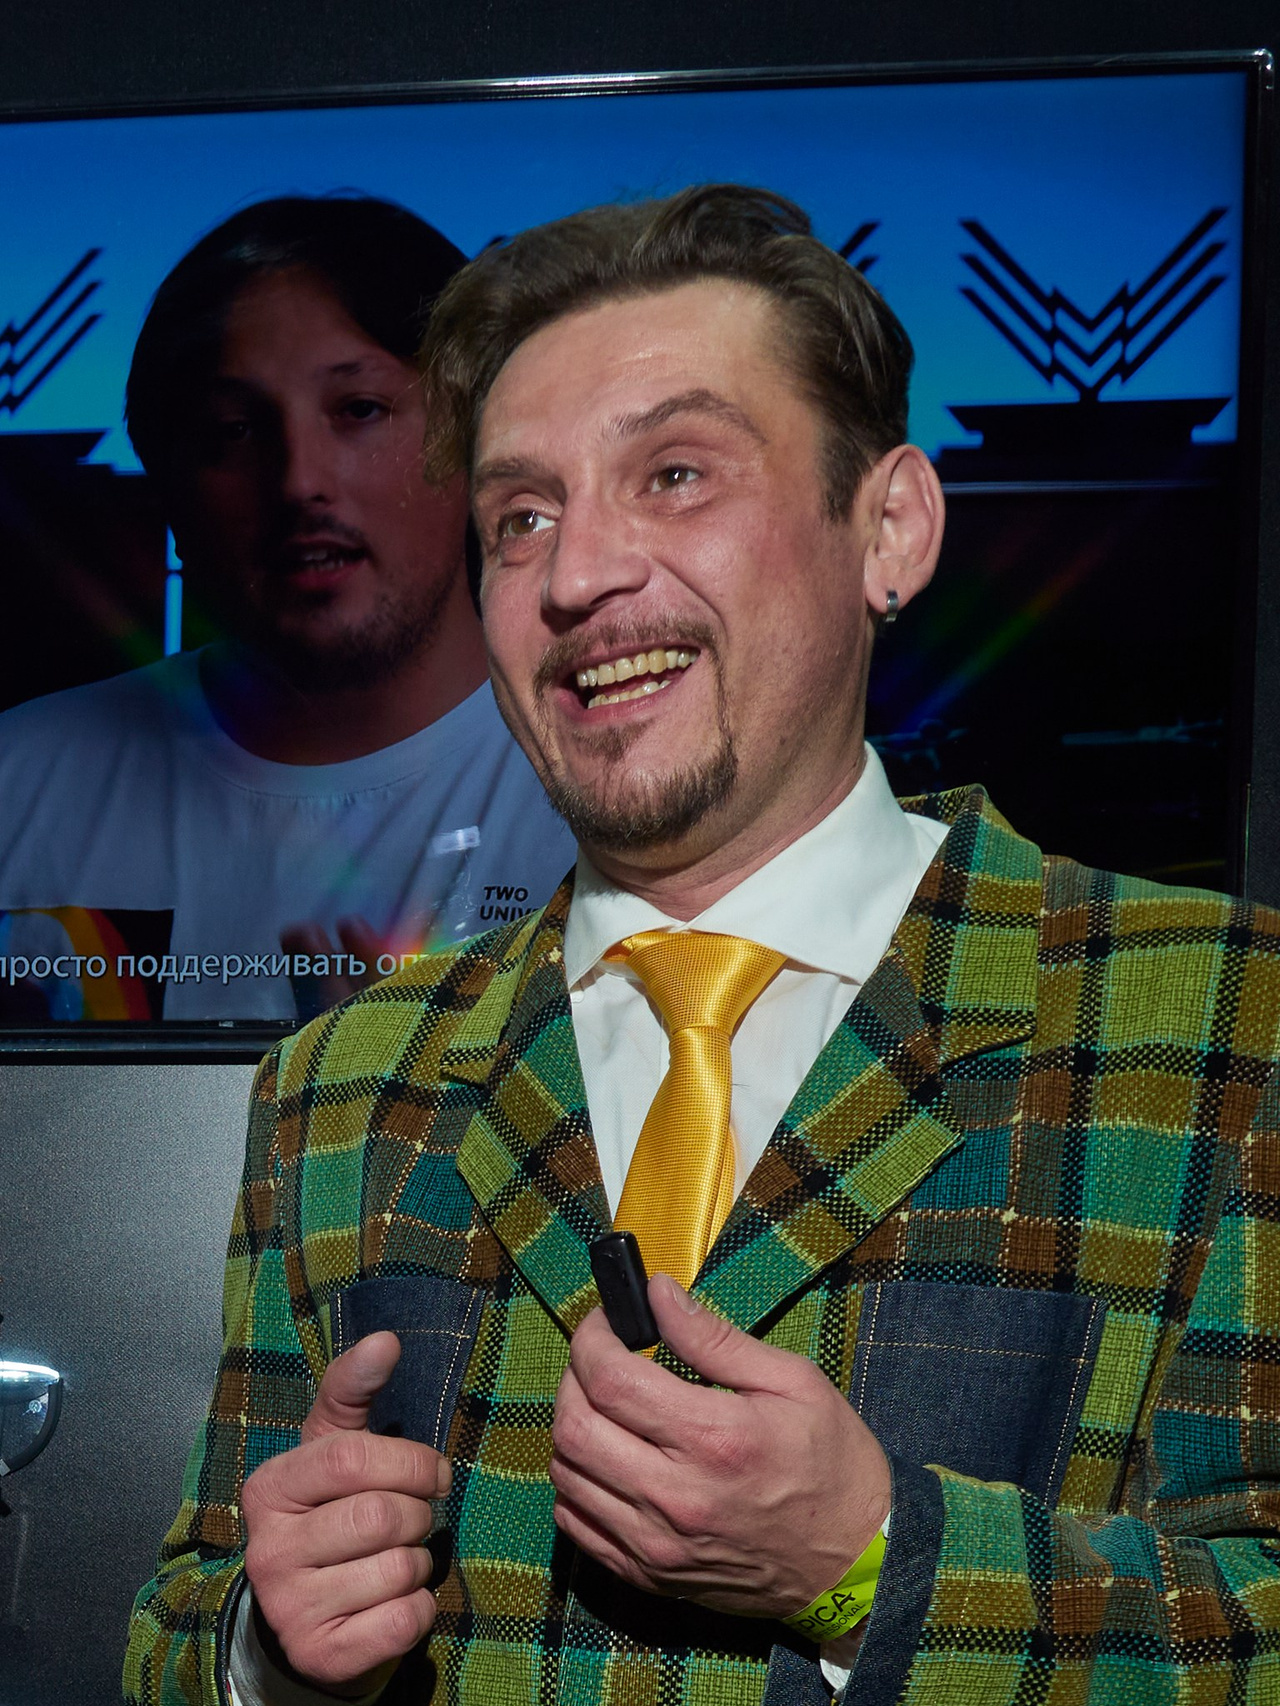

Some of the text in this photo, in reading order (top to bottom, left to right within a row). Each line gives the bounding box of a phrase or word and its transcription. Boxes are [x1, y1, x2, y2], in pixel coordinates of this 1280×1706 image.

[483, 886, 529, 902] TWO
[480, 905, 539, 922] UNIV
[117, 954, 367, 985] поддерживать
[376, 953, 430, 976] оп
[797, 1591, 856, 1631] PICA
[822, 1602, 866, 1637] ESSIONAL
